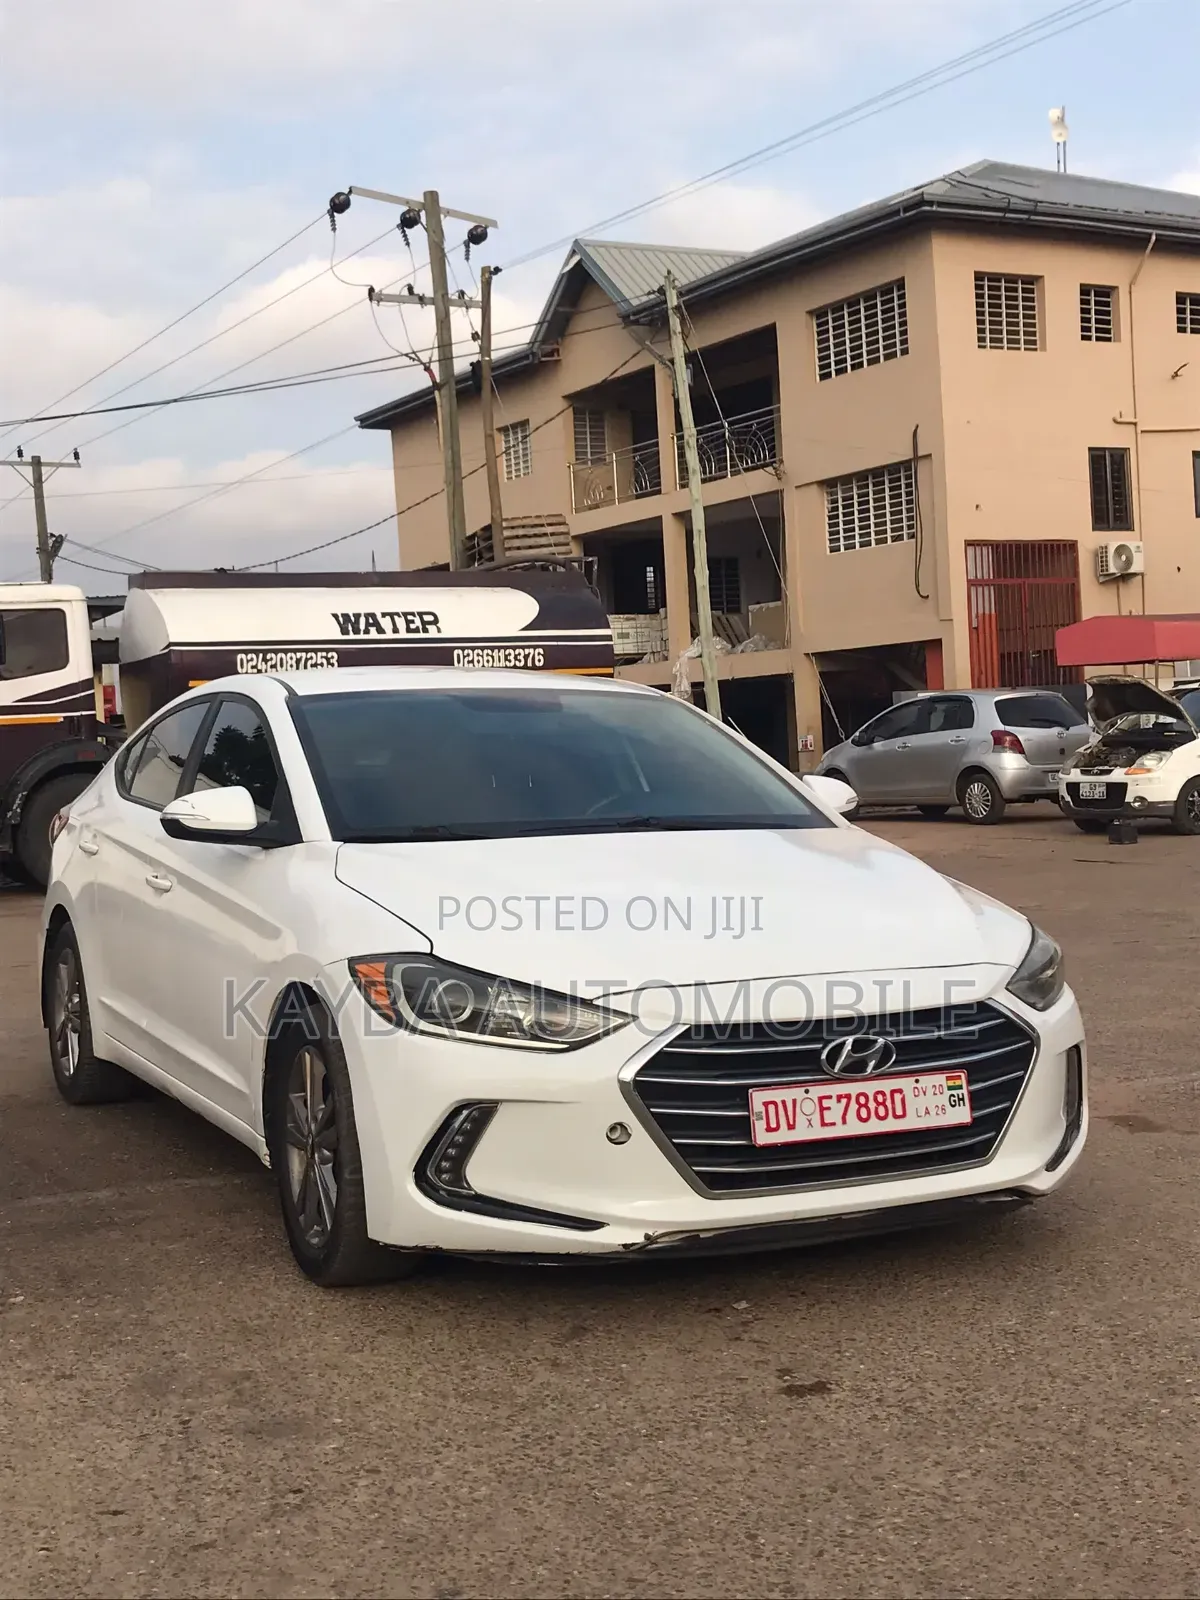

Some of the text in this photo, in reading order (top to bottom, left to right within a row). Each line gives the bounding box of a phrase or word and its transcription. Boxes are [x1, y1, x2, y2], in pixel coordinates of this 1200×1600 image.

[331, 611, 442, 636] WATER
[236, 652, 339, 674] 0242087253
[453, 648, 545, 668] 0266113376
[912, 1083, 944, 1098] DV 20
[948, 1092, 966, 1108] GH
[761, 1098, 797, 1133] DV
[915, 1104, 947, 1118] LA 26
